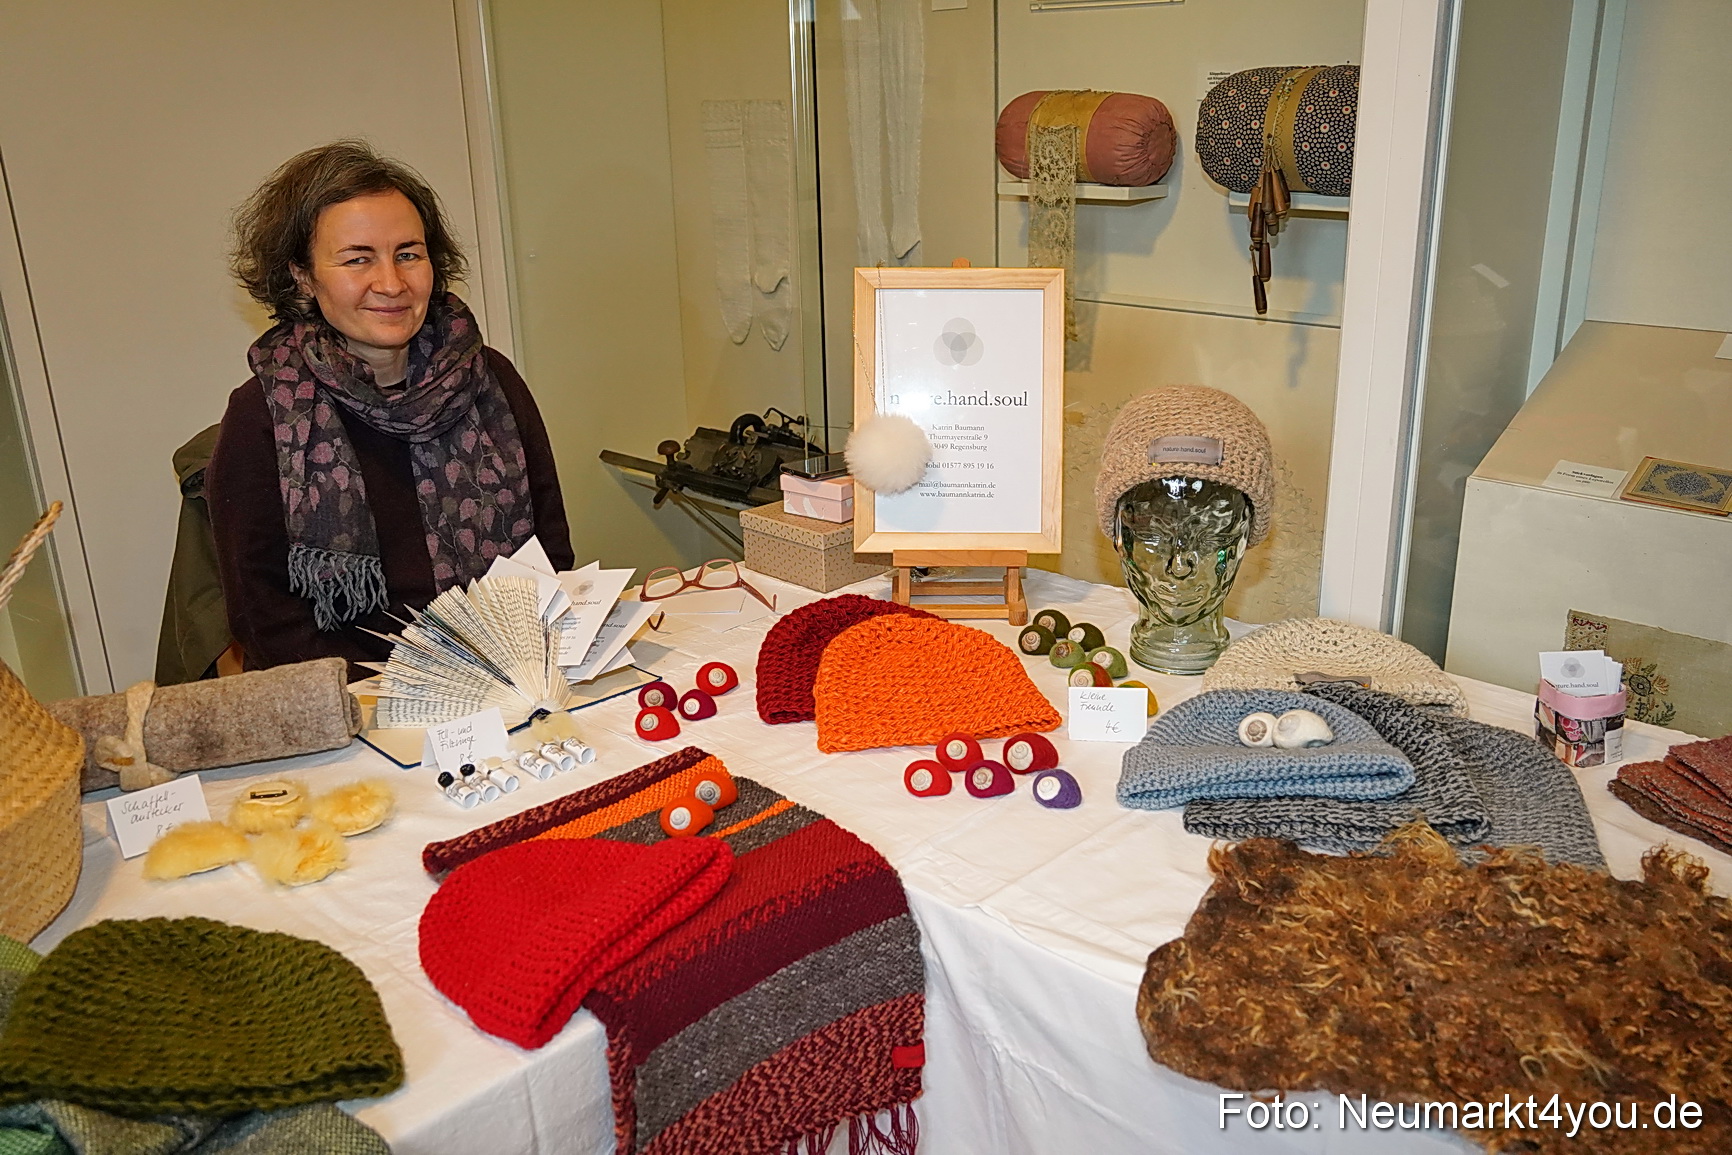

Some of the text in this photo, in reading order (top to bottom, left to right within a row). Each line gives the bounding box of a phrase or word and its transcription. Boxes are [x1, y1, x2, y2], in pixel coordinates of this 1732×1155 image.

[889, 390, 1029, 407] ne.hand.soul
[928, 433, 982, 442] Thurmayerstraße
[950, 443, 988, 452] Regensburg
[962, 462, 975, 470] 895
[977, 462, 985, 470] 19
[919, 481, 997, 490] mail@baumannkatrin.de
[919, 491, 995, 499] www.baumannkatrin.de
[457, 721, 473, 736] und
